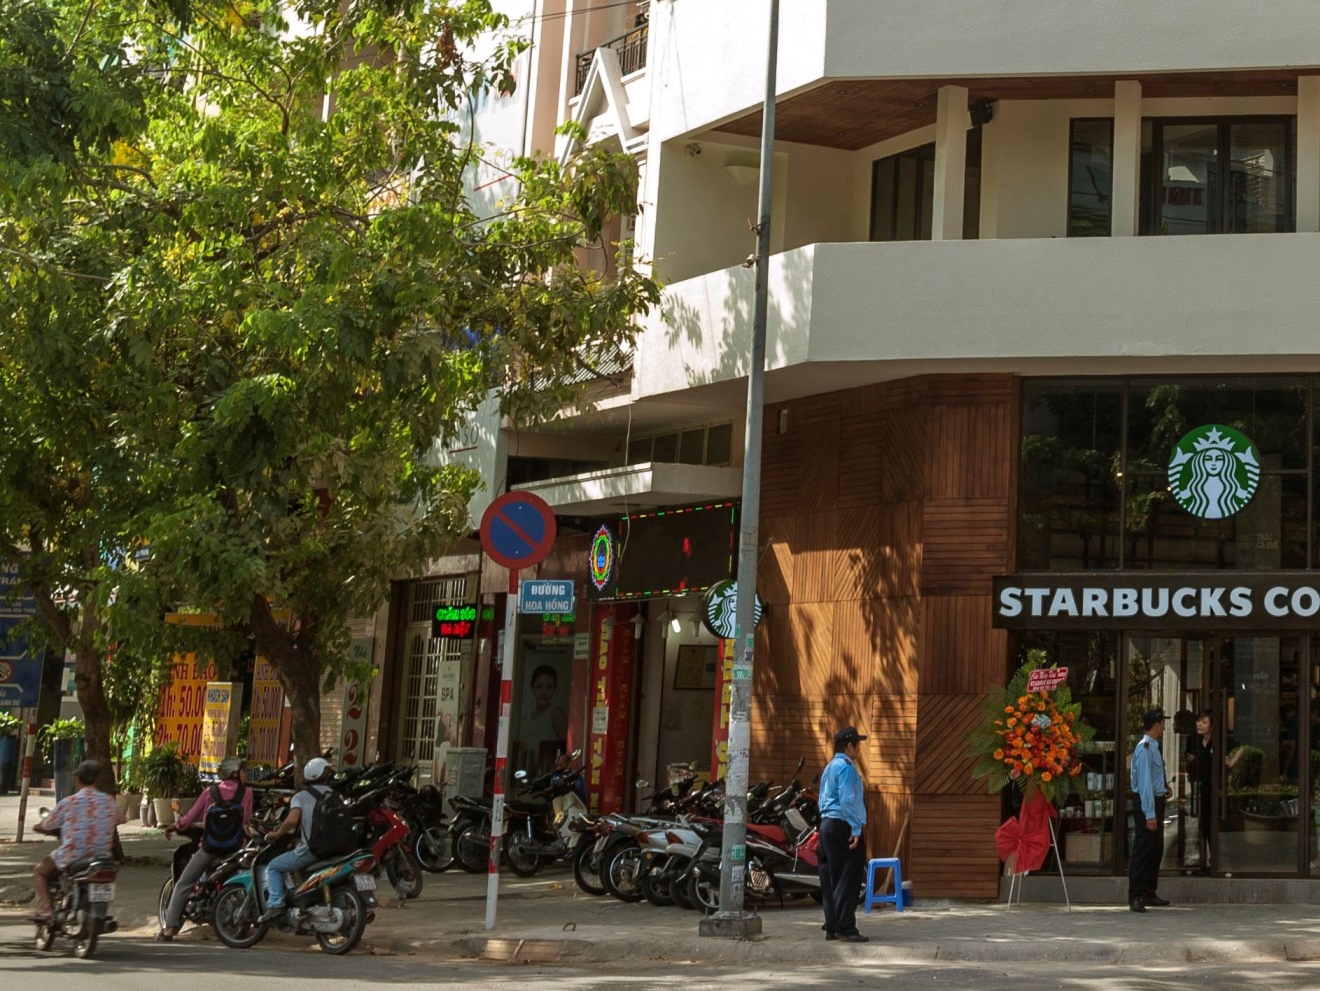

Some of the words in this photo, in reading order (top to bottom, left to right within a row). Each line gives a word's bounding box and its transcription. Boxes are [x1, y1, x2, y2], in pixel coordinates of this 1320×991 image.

[525, 601, 542, 611] HOA
[999, 586, 1252, 617] STARBUCKS
[441, 688, 454, 701] SPA
